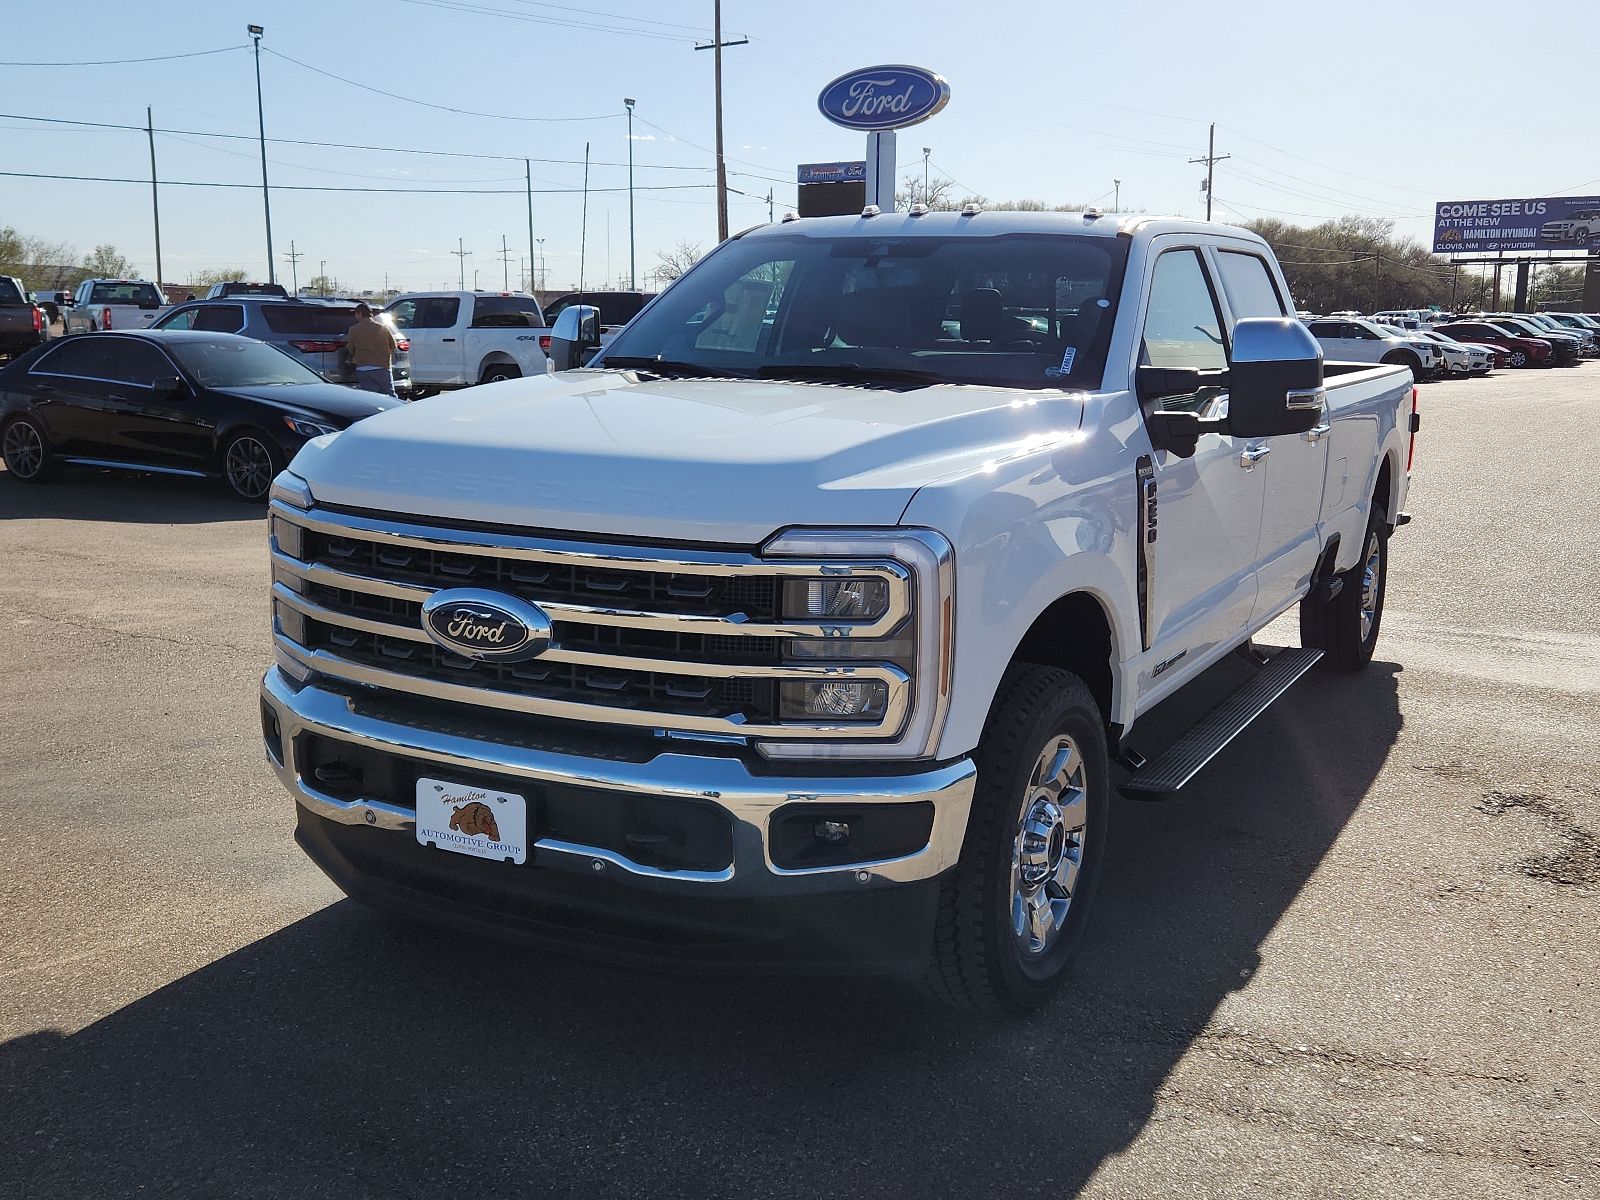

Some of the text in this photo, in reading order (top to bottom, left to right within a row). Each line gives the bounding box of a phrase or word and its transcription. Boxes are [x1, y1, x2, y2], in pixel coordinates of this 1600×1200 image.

[841, 78, 915, 117] Ford
[848, 165, 863, 176] Ford
[1439, 202, 1547, 218] COME SEE US
[1438, 217, 1501, 227] AT THE NEW
[1463, 227, 1537, 240] HAMILTON HYUNDAI
[447, 608, 506, 643] Ford
[441, 790, 488, 805] Hamilton
[420, 828, 484, 848] AUTOMOTIVE
[486, 841, 521, 854] GROUP
